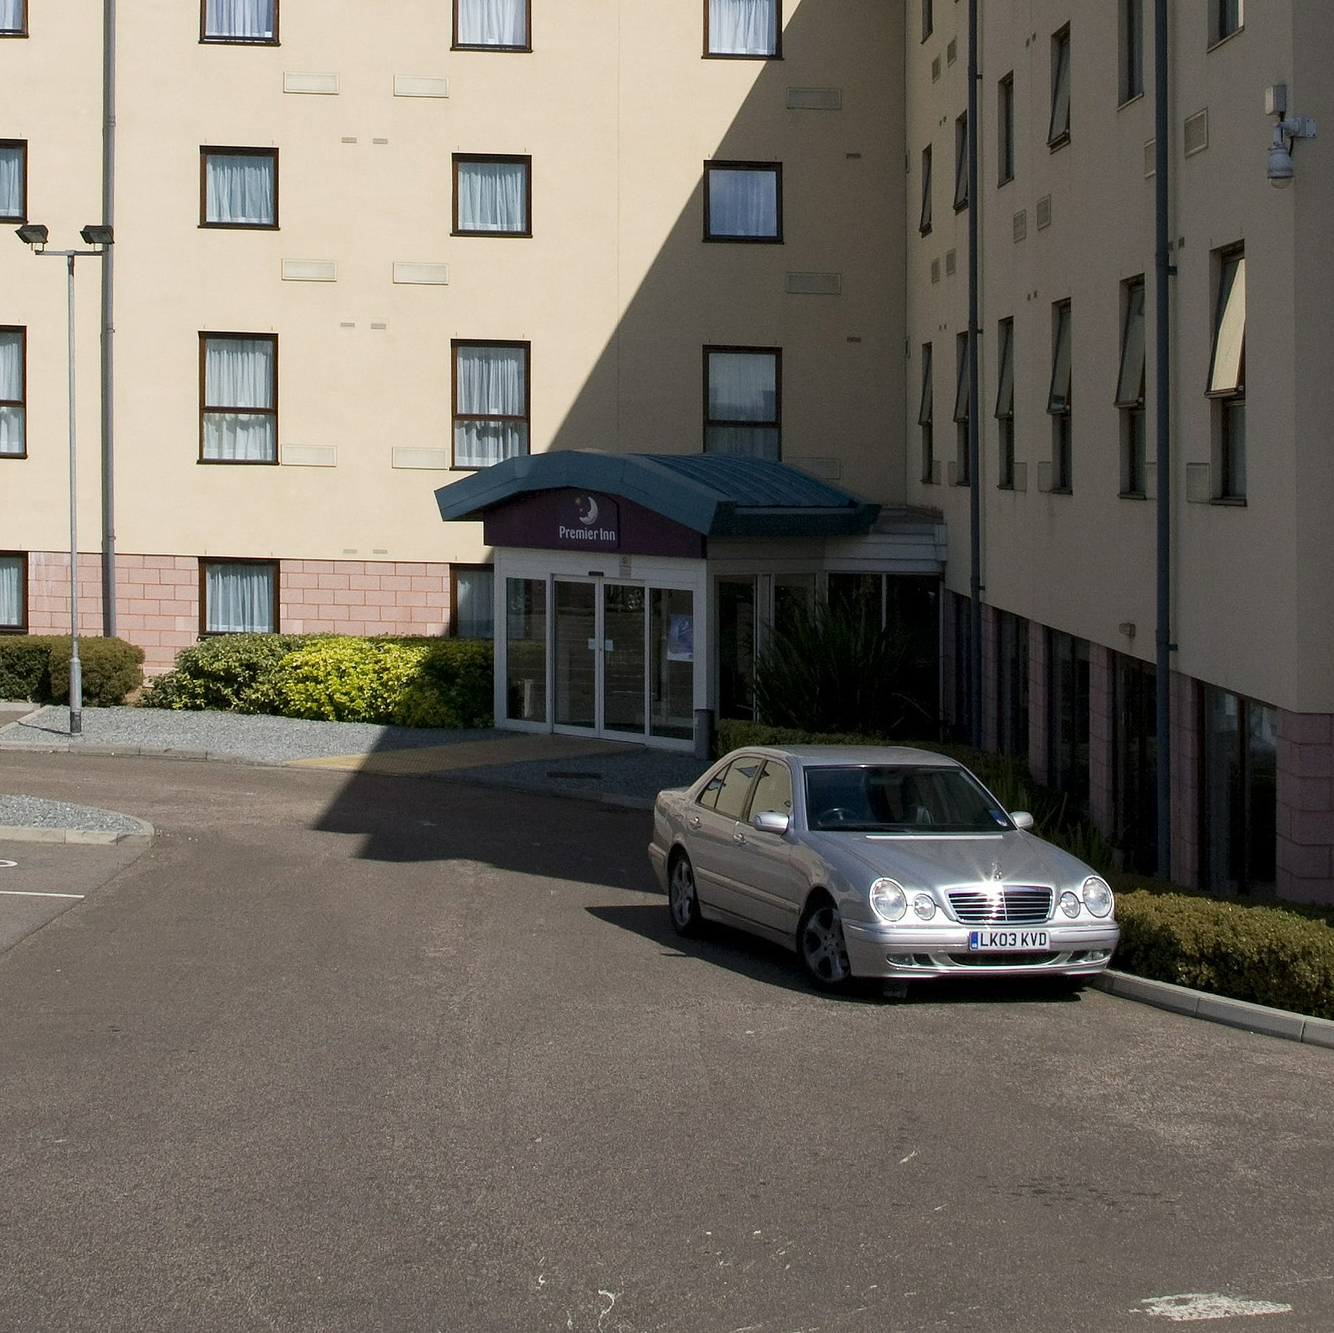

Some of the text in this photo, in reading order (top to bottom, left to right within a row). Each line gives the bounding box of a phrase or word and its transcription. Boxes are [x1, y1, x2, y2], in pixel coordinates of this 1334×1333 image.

[559, 525, 616, 541] Premier Inn
[980, 932, 1047, 947] LK03 KVD
